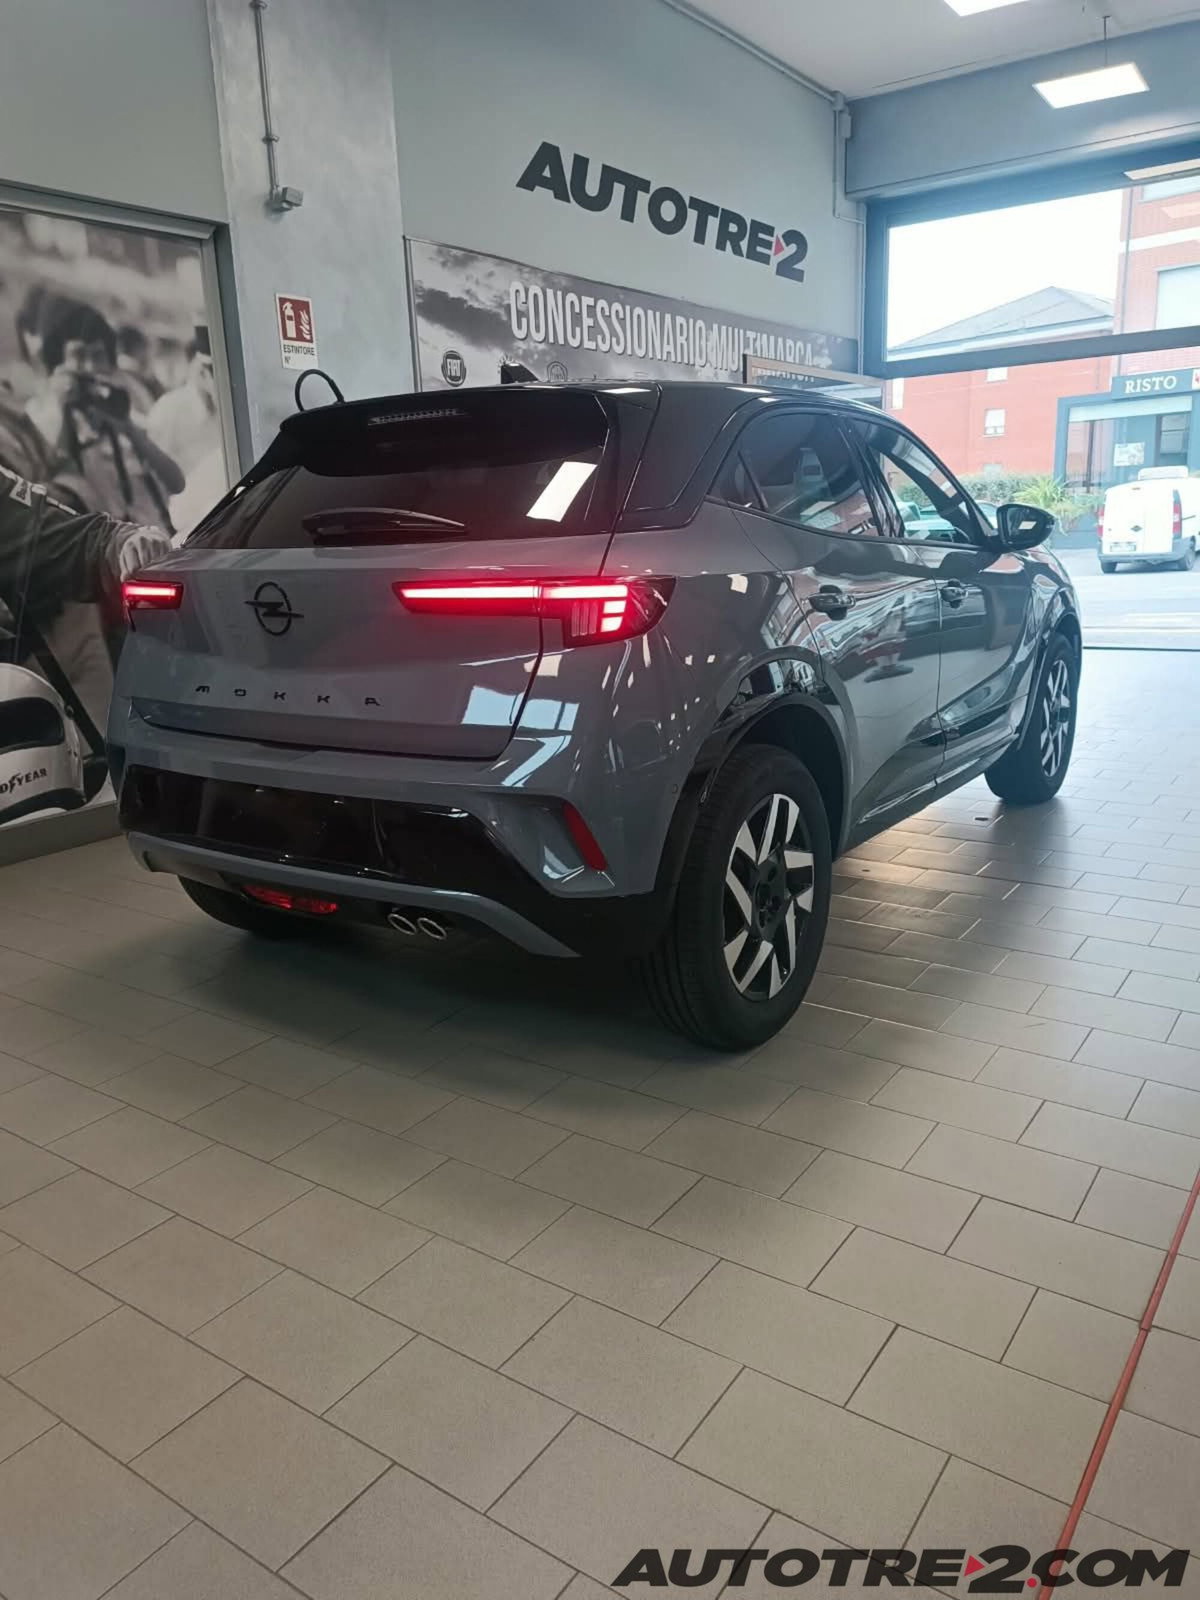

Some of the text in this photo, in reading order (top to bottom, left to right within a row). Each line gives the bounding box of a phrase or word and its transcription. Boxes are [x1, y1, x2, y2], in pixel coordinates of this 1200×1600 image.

[509, 281, 707, 367] CONCESSIONARIO
[283, 344, 315, 356] ESTINTORE
[1124, 375, 1177, 394] RISTO
[195, 685, 380, 706] MOKKA
